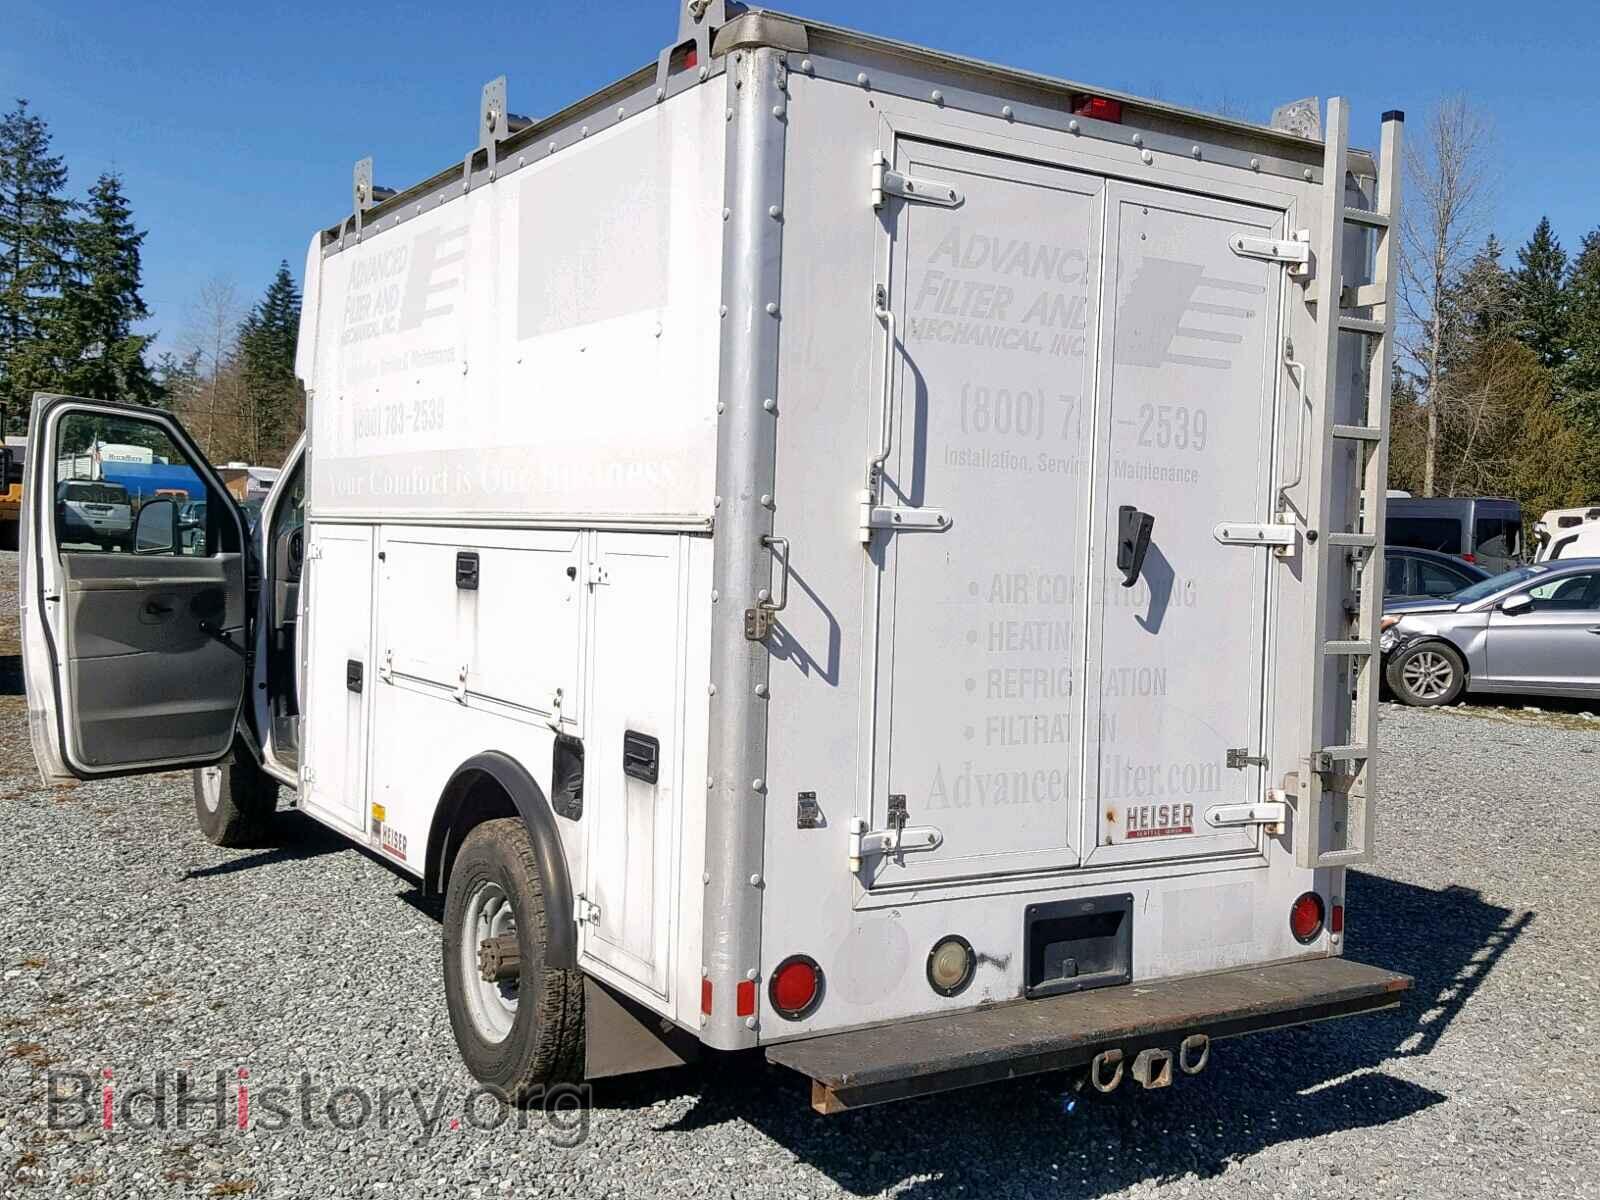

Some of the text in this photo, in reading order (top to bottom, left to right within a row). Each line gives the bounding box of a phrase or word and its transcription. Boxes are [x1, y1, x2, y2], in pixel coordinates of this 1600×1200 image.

[928, 226, 1124, 284] ADVANC
[913, 270, 1014, 322] FILTER
[385, 395, 445, 436] 783-2539
[959, 381, 1208, 452] (800) 7-2539
[368, 463, 449, 496] Comfort
[944, 445, 1200, 485] Installation, Servi Maintenance
[987, 573, 1029, 606] AIR
[987, 621, 1073, 652] HEATIN
[985, 667, 1168, 699] REFRIGATION
[922, 754, 1223, 811] Advanceilter.com
[1126, 803, 1193, 830] HEISER
[382, 823, 407, 854] HEISER
